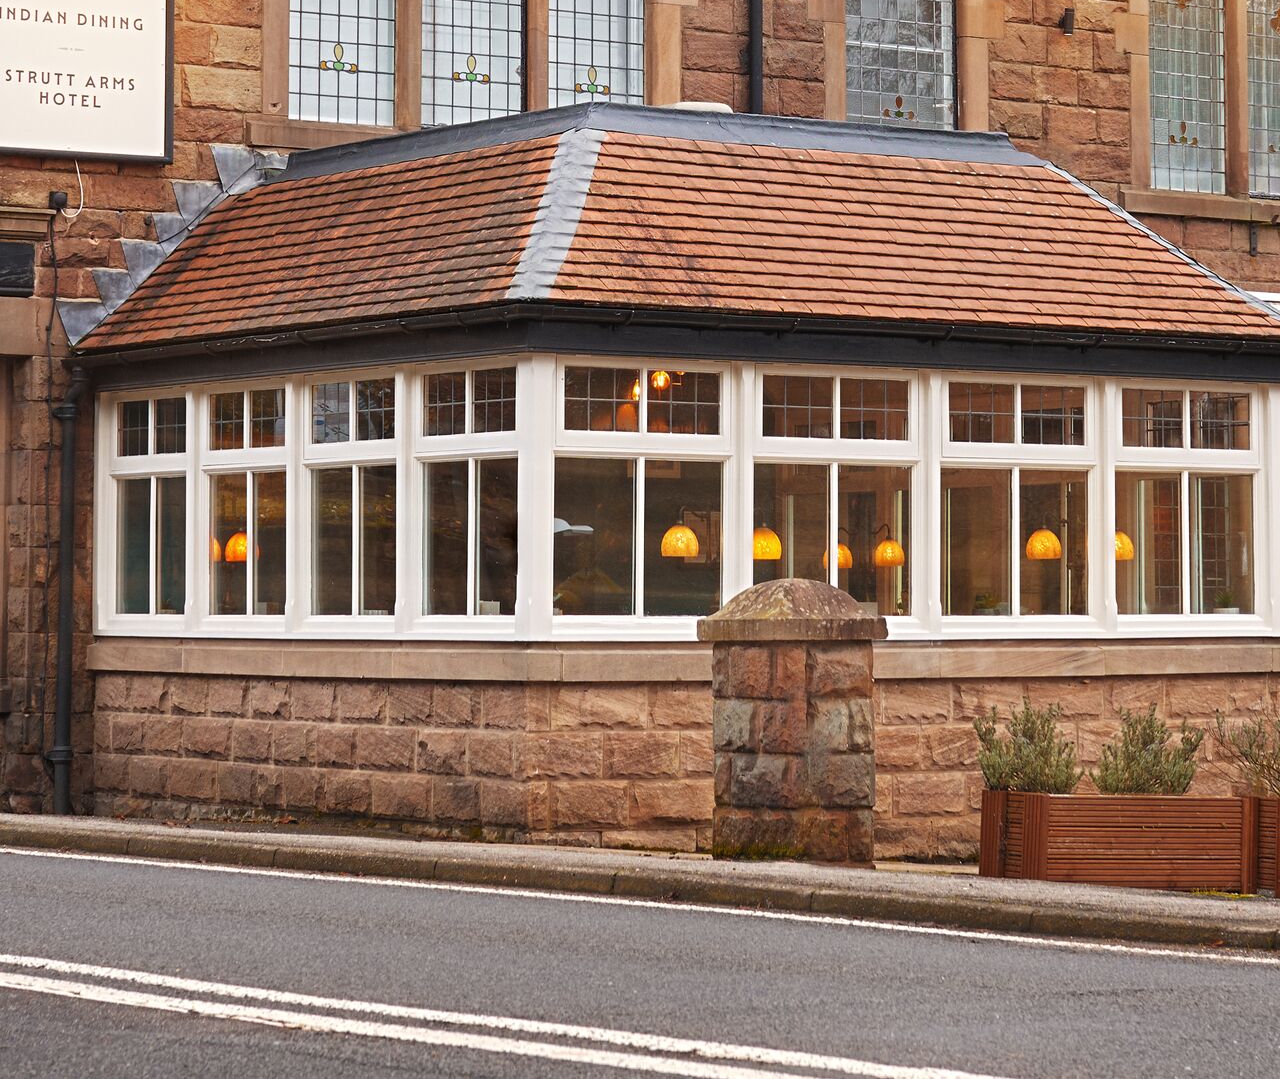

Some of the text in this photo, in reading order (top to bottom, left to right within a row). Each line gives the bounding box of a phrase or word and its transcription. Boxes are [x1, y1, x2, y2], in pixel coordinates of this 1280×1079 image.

[77, 13, 143, 31] DINING
[5, 69, 136, 91] STRUTT ARMS
[39, 91, 101, 109] HOTEL
